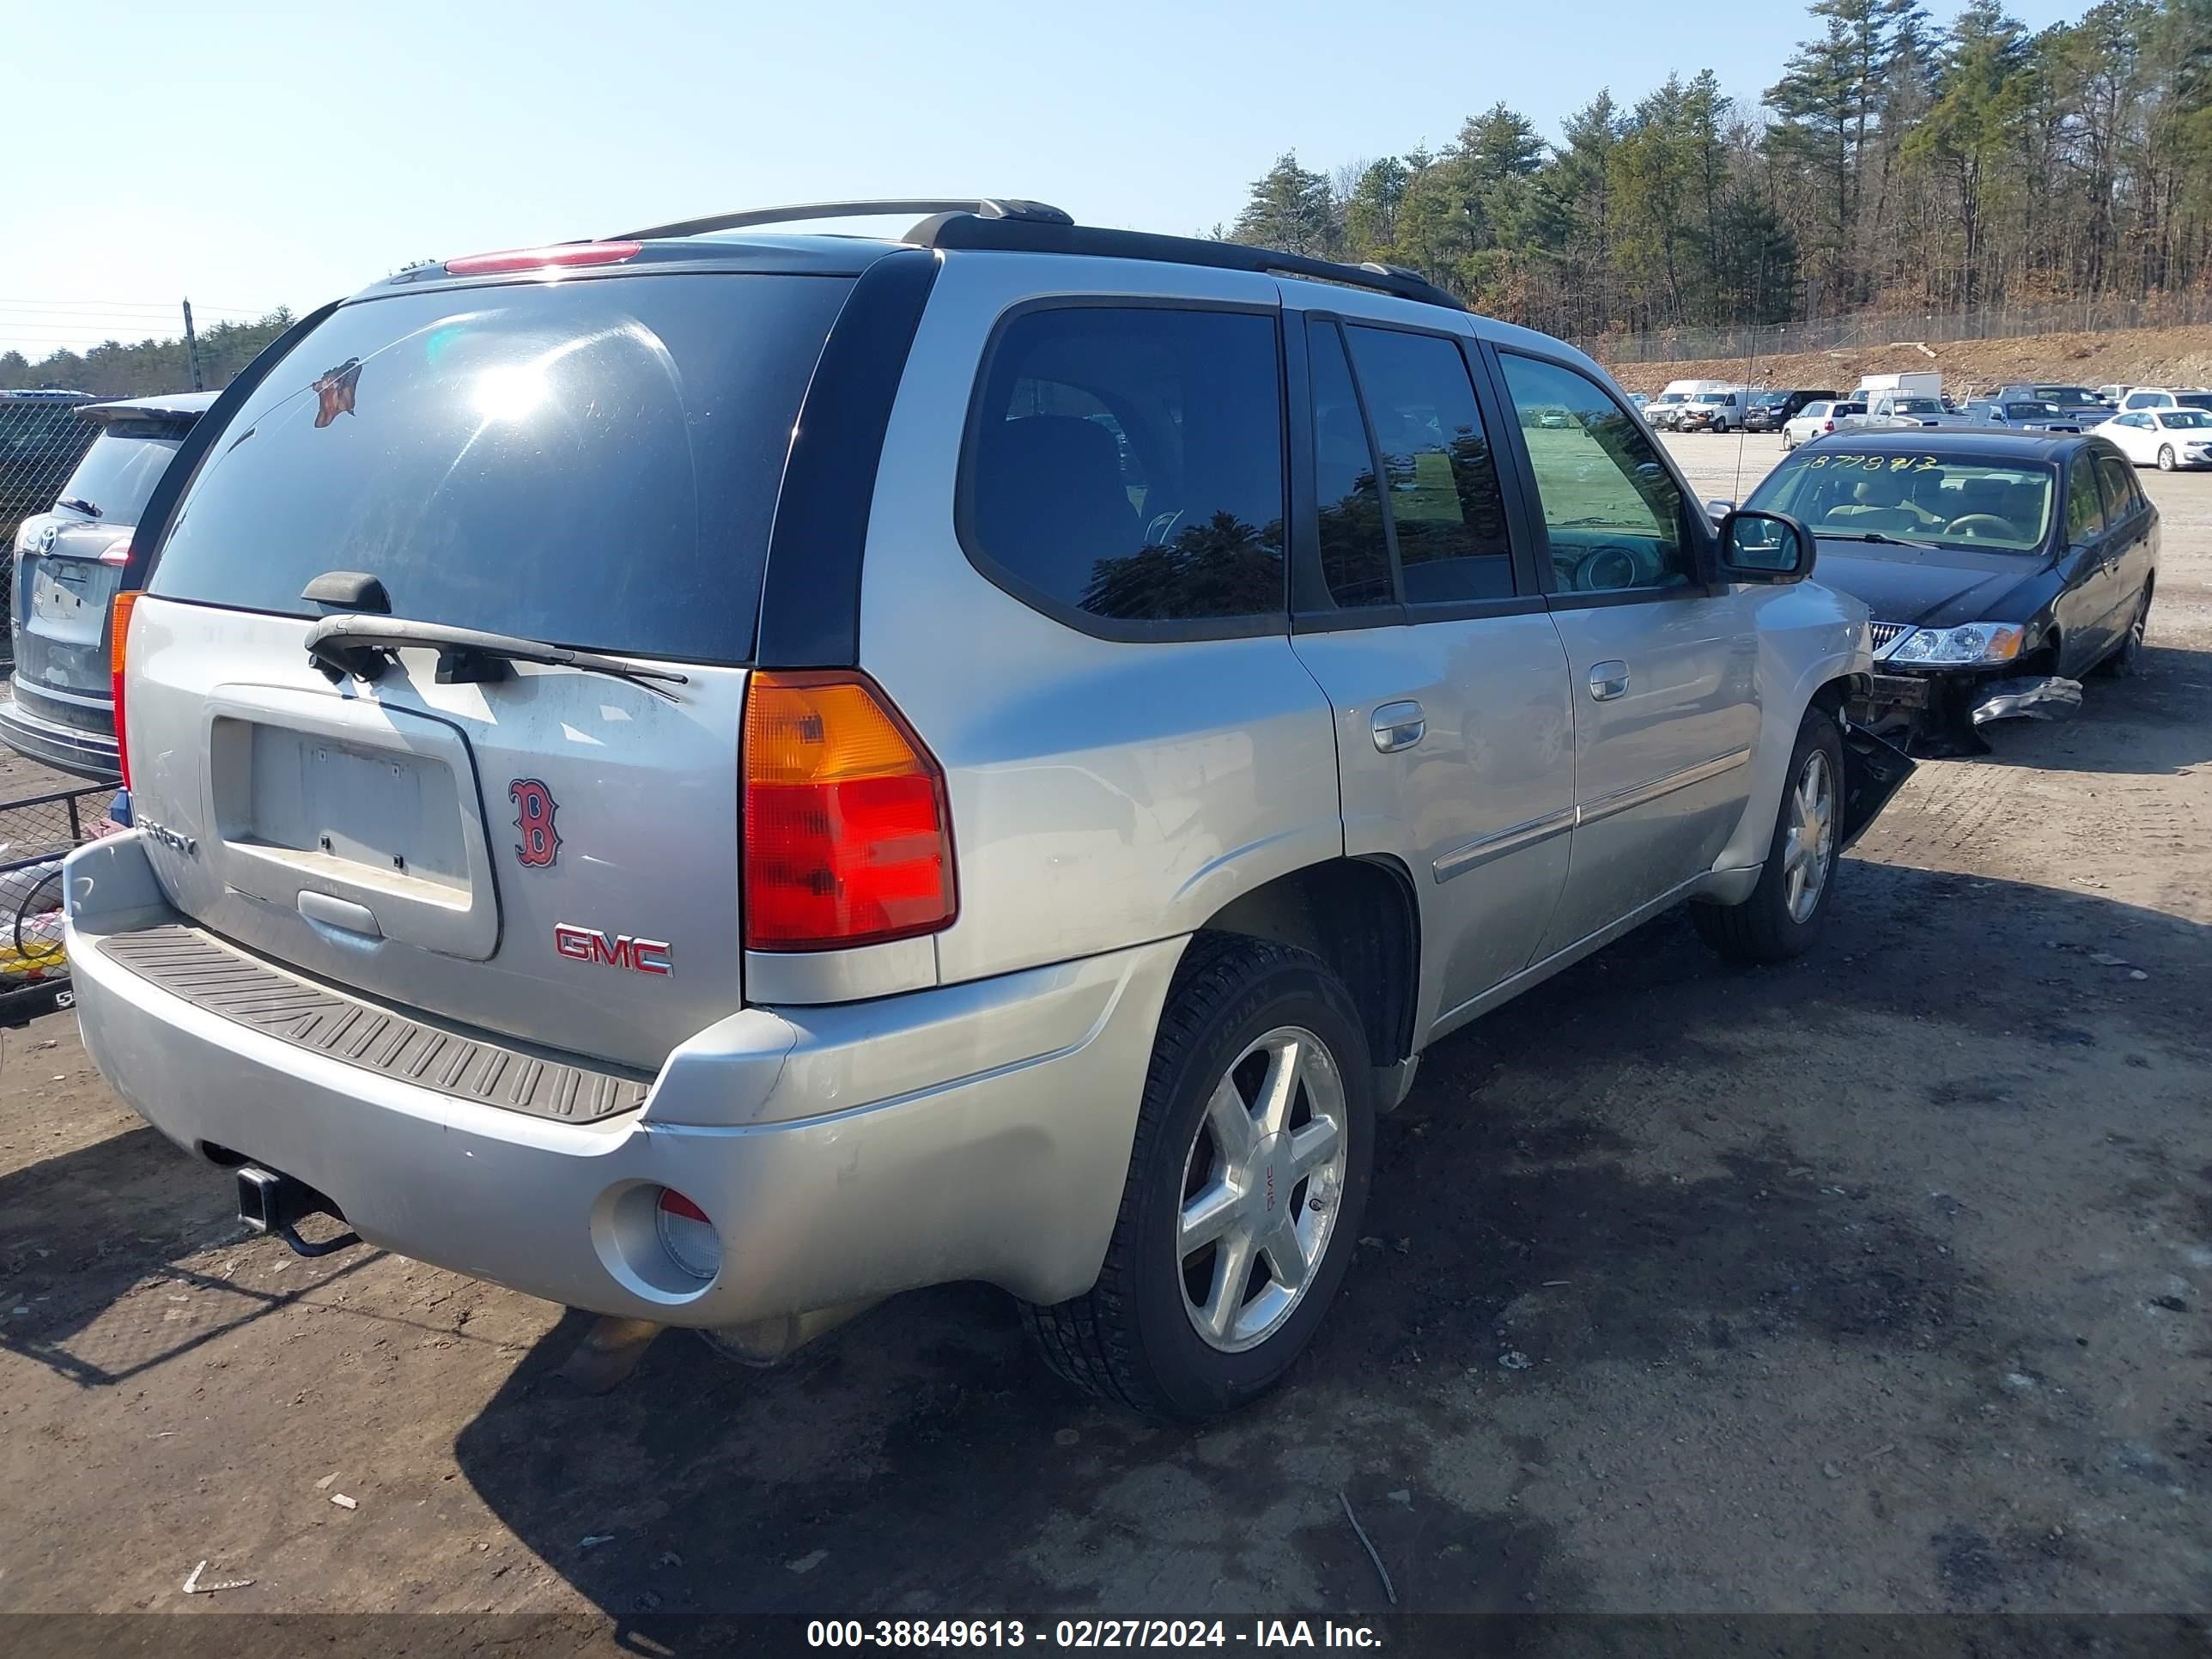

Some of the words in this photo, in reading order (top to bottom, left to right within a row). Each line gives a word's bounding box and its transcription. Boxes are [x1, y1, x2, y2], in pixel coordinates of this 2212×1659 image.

[508, 778, 563, 868] B
[554, 921, 673, 978] GMC
[1266, 1165, 1275, 1212] GMC
